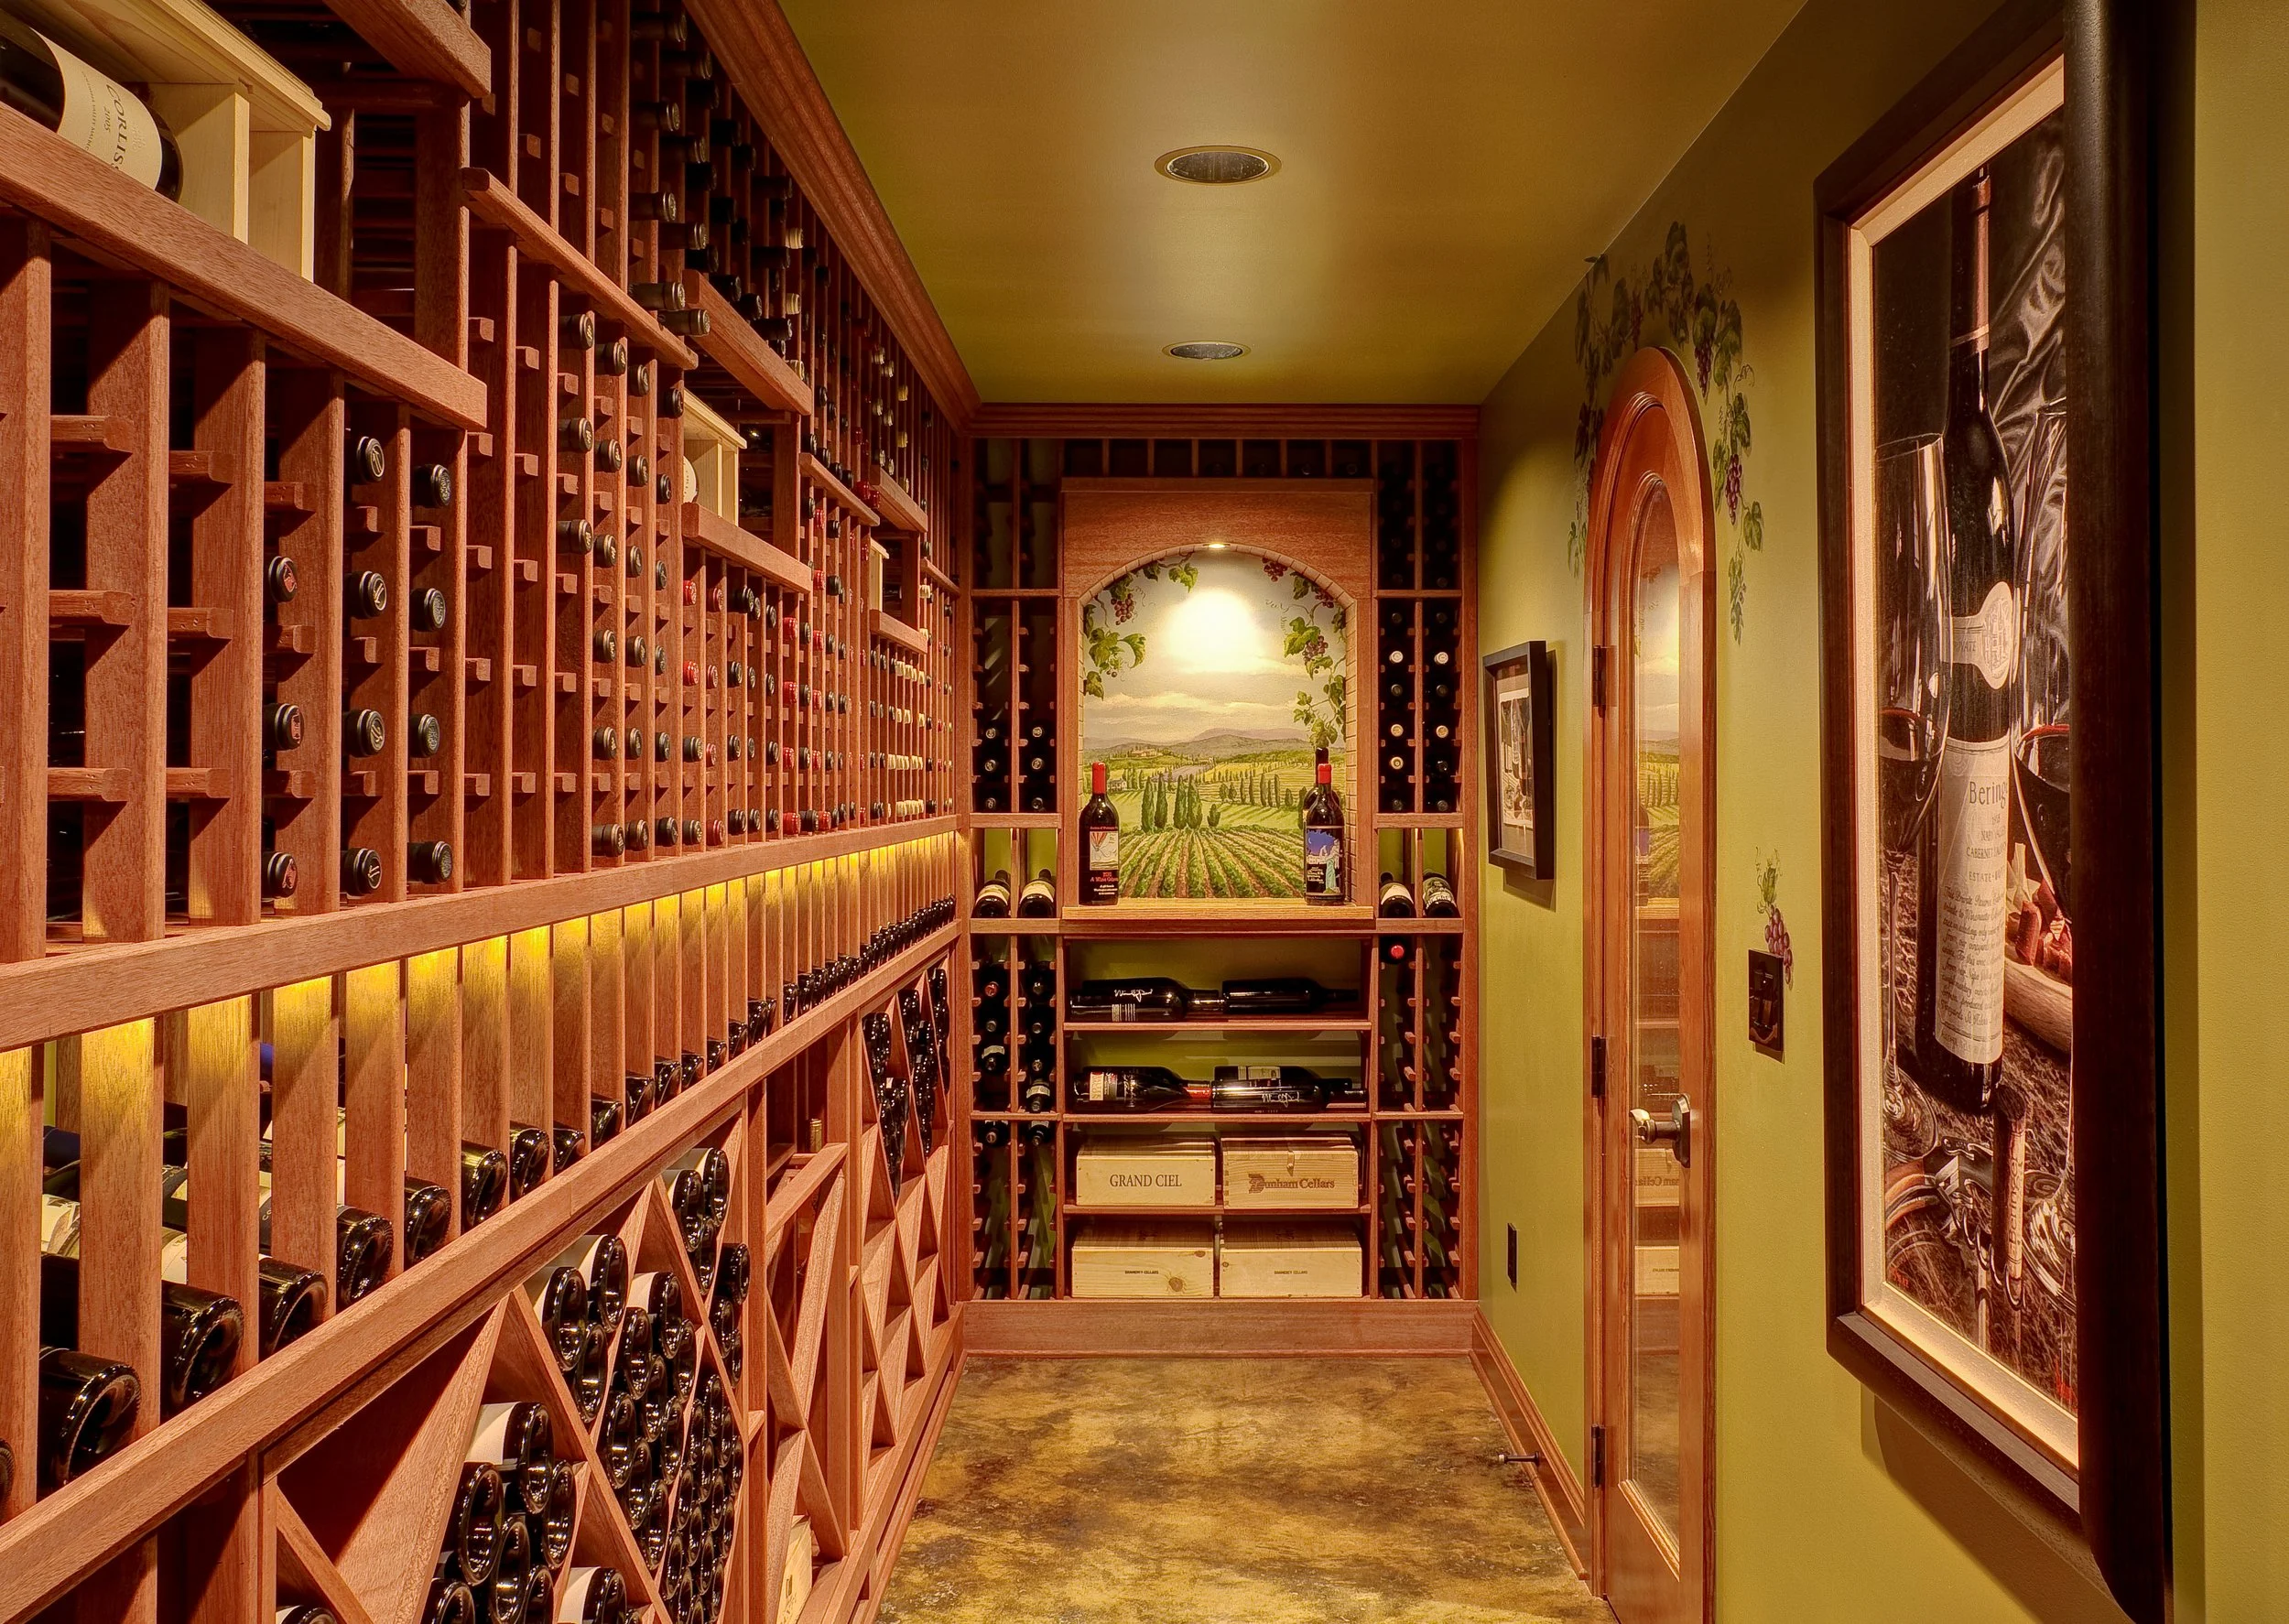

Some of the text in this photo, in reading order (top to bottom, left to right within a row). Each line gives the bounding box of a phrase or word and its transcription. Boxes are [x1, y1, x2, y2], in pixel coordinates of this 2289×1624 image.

[1969, 780, 2008, 809] Bering
[1110, 1174, 1182, 1187] GRAND CIEL
[1248, 1173, 1335, 1194] Dunham Cellars
[2009, 1156, 2019, 1245] Beringer
